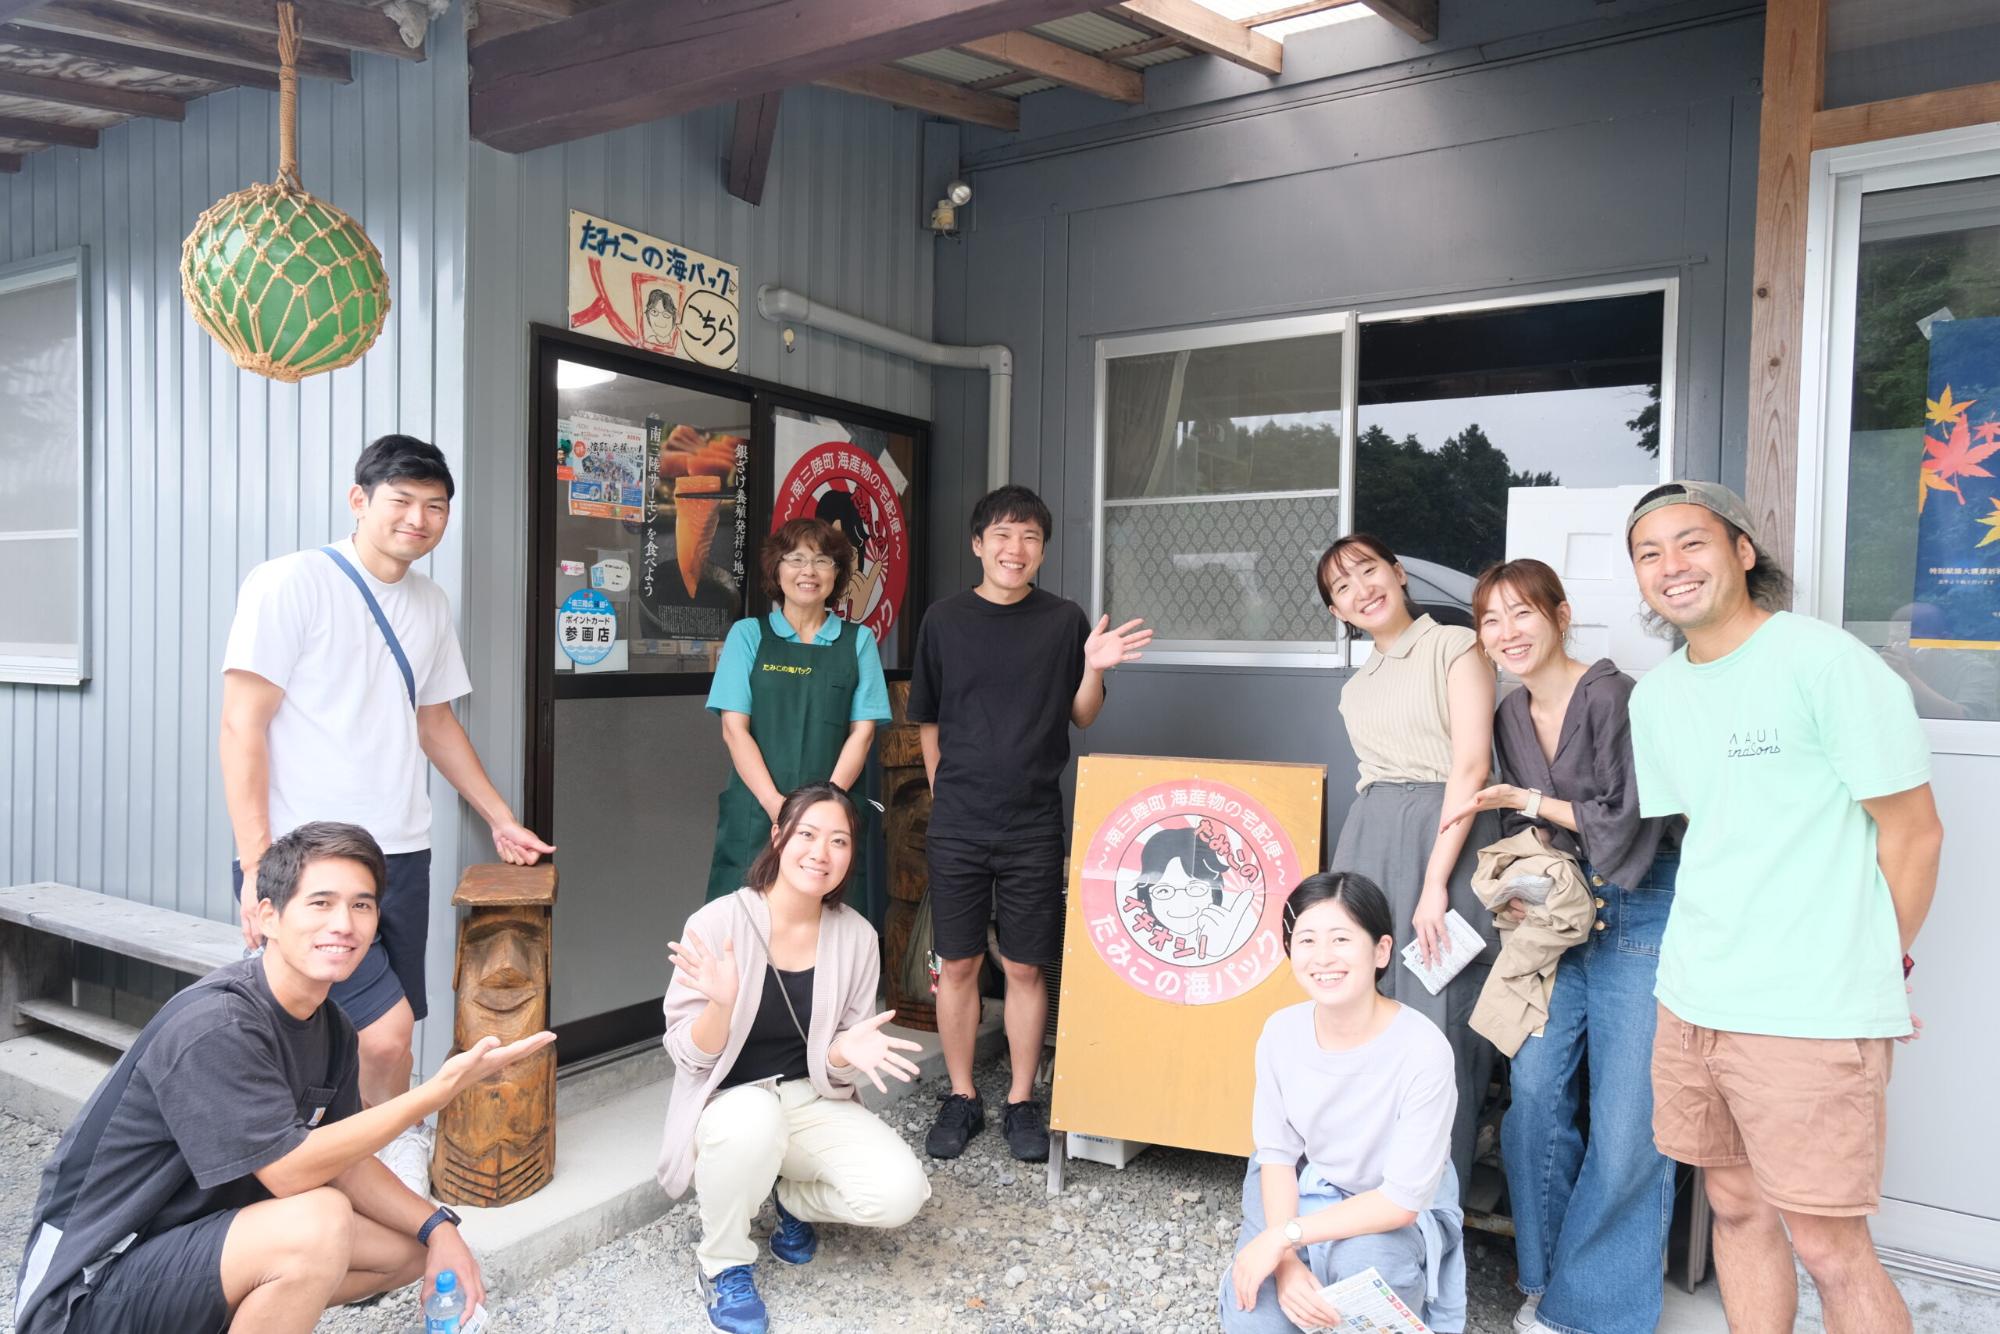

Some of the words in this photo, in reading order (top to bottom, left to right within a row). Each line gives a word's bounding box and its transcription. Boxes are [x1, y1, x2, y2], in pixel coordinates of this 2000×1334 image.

[579, 219, 731, 296] たみこの海パック
[685, 303, 738, 356] こちら
[643, 425, 662, 598] 南三陸サーモンを食べよう
[732, 443, 750, 588] 銀ざけ養殖発祥の地で
[565, 615, 610, 625] ポイントカード
[565, 626, 610, 643] 参画店
[762, 663, 812, 675] たみこの海パック
[1194, 819, 1260, 884] たみこの
[1091, 912, 1280, 999] たみこの海パック
